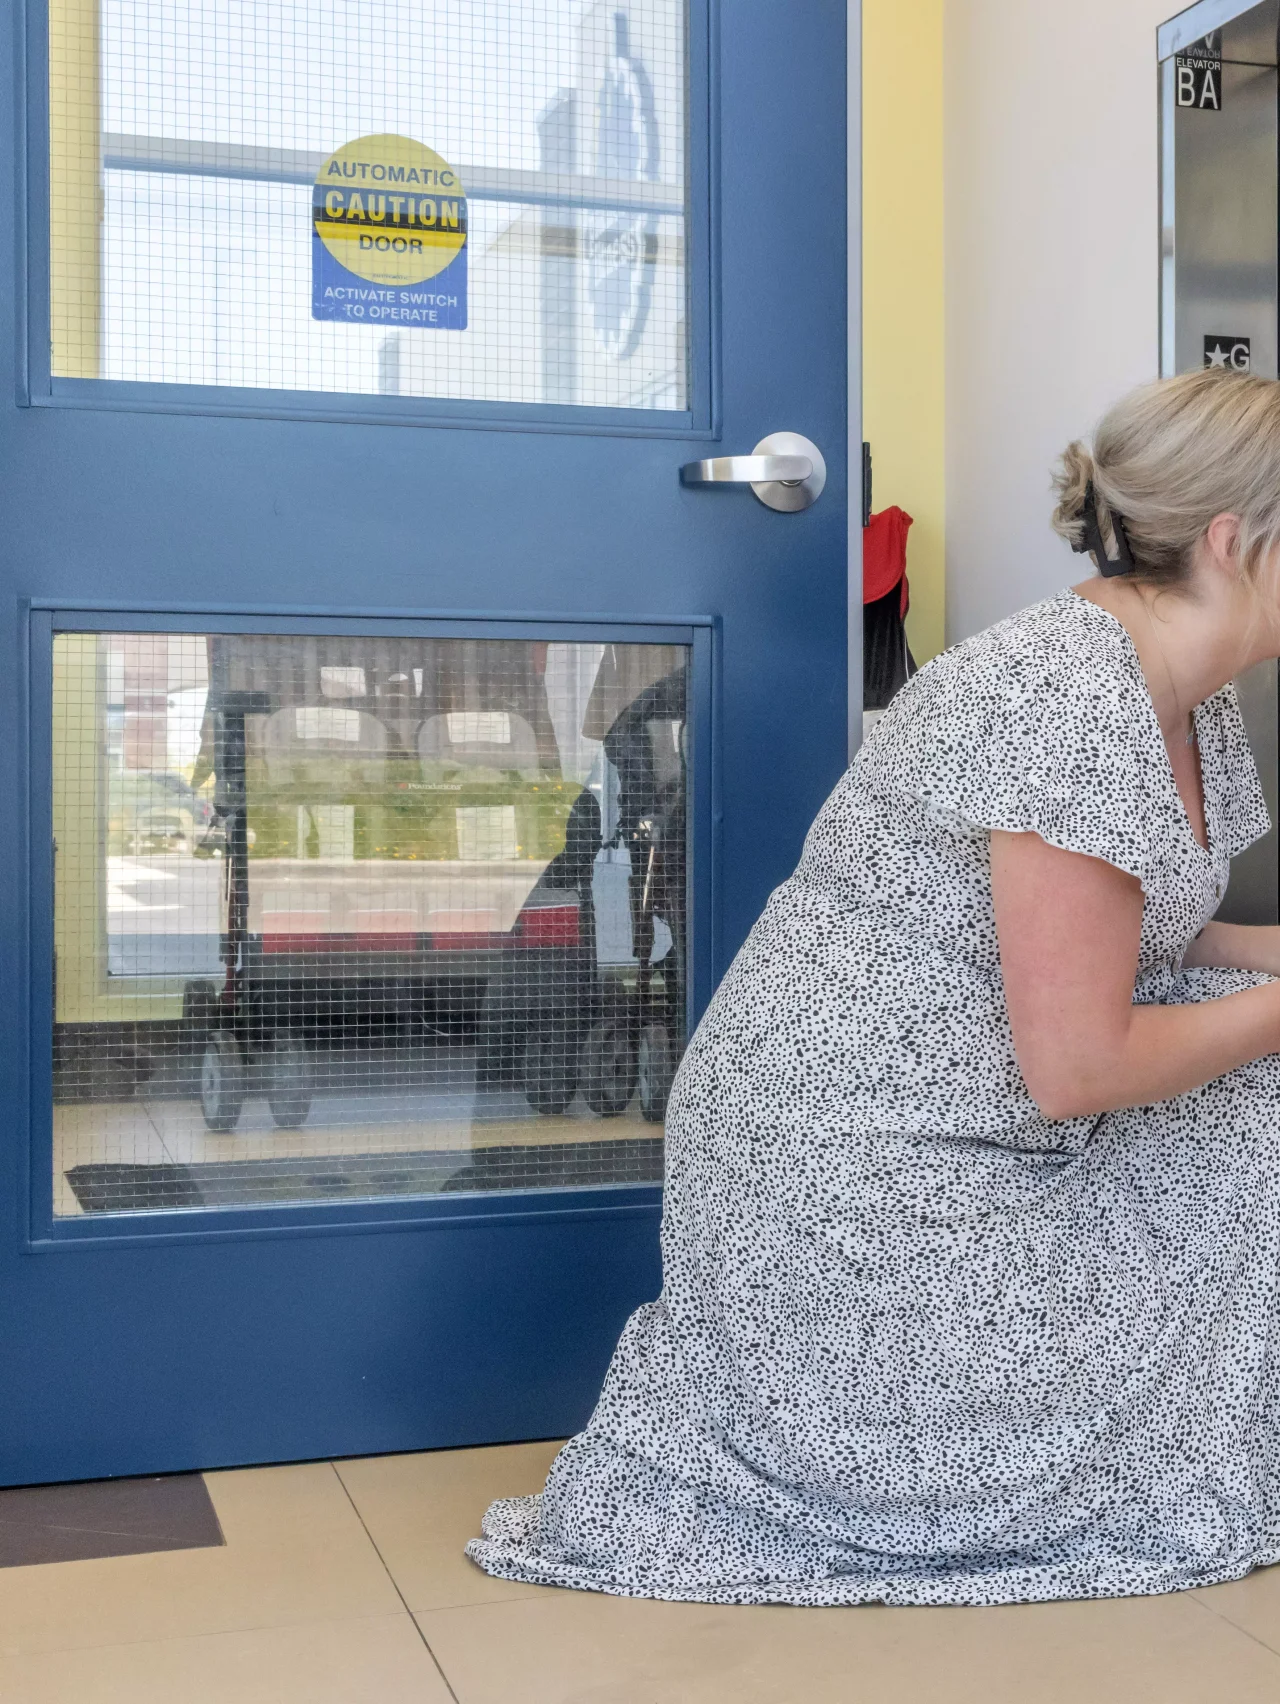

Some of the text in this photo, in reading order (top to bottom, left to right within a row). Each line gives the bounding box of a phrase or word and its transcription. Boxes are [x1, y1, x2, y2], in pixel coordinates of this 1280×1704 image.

[1176, 57, 1220, 71] ELEVATOR
[327, 160, 455, 187] AUTOMATIC
[324, 190, 459, 228] CAUTION
[359, 233, 423, 254] DOOR
[324, 286, 457, 308] ACTIVATE SWITCH
[344, 303, 438, 322] TO OPERATE
